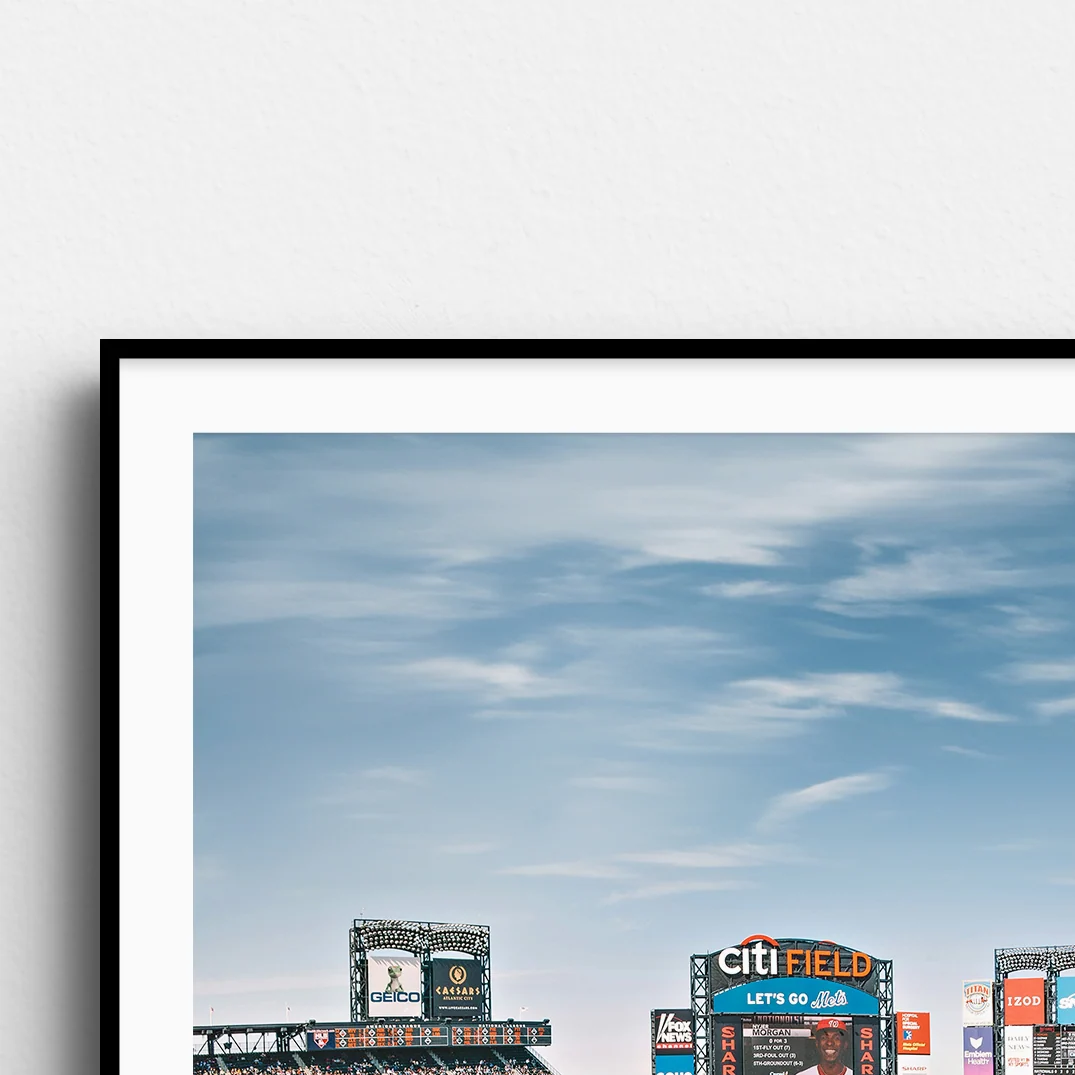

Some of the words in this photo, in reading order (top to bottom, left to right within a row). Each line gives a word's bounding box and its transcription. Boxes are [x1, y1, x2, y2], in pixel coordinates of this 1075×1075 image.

[786, 949, 872, 977] FIELD
[435, 986, 480, 995] CAESARS
[966, 985, 989, 995] TITAN
[370, 992, 420, 1003] GEICO
[747, 993, 785, 1005] LET'S
[788, 993, 808, 1005] GO
[811, 990, 848, 1009] Mets
[1007, 996, 1041, 1006] IZOD
[668, 1021, 691, 1032] FOX
[662, 1032, 692, 1043] NEWS
